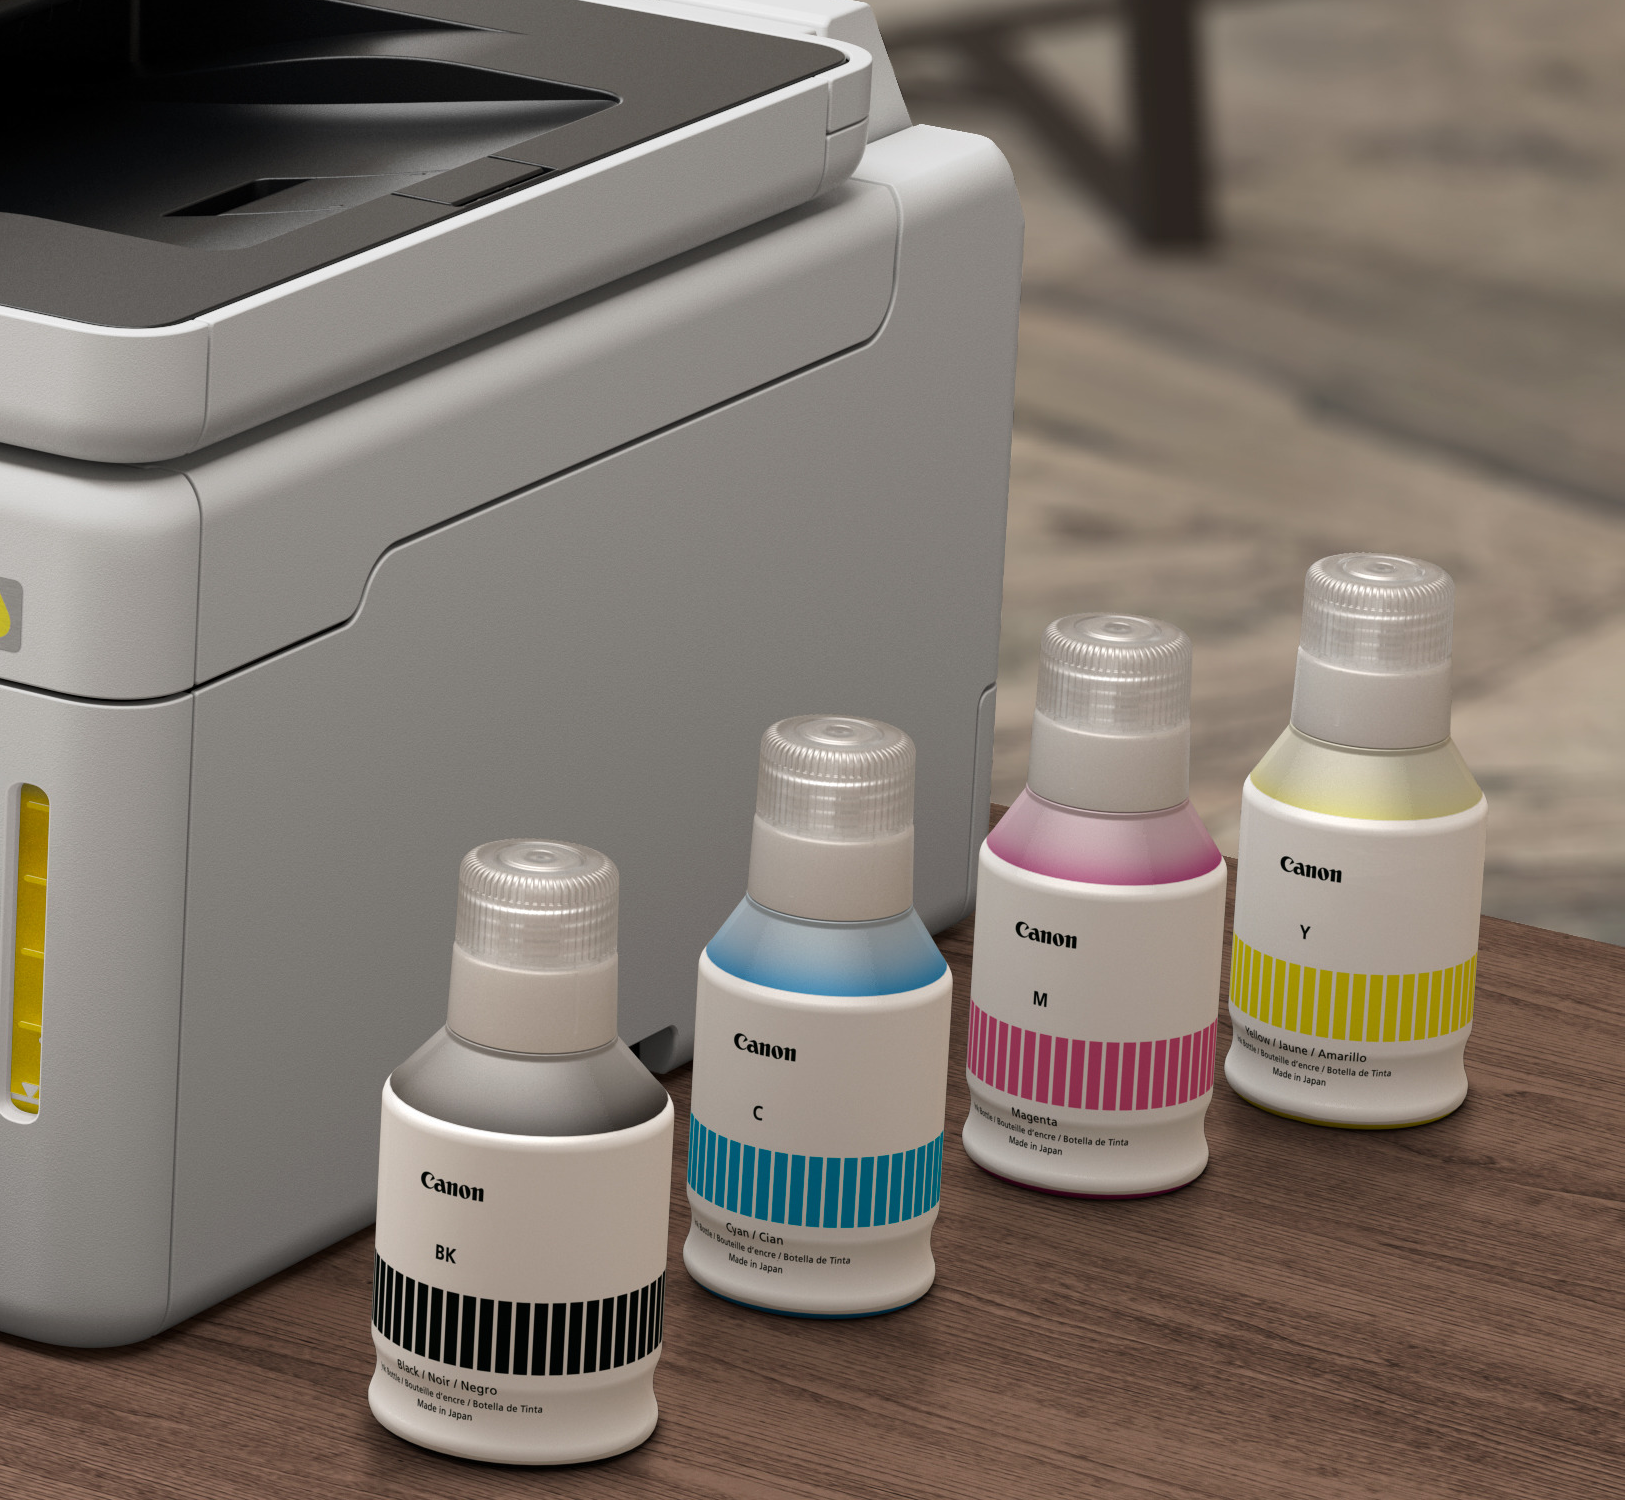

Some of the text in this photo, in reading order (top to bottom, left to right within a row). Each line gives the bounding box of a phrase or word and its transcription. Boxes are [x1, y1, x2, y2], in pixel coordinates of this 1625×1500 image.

[1279, 855, 1343, 884] Canon
[1014, 920, 1078, 950] Canon
[1299, 923, 1312, 941] Y
[1032, 990, 1048, 1009] M
[733, 1032, 797, 1063] Canon
[1244, 1025, 1367, 1063] Yellow Jaune Amarillo
[1261, 1050, 1289, 1066] Bouteille
[1327, 1066, 1356, 1077] Botella
[1358, 1069, 1369, 1077] de
[1371, 1069, 1391, 1078] Tinta
[1272, 1066, 1326, 1087] Made in Japan
[752, 1104, 764, 1122] C
[1011, 1106, 1058, 1127] Magenta
[997, 1117, 1025, 1134] Bouteille
[1063, 1135, 1093, 1146] Botella
[1095, 1138, 1106, 1146] de
[1108, 1138, 1129, 1147] Tinta
[1008, 1135, 1063, 1156] Made in Japan
[420, 1170, 485, 1204] Canon
[726, 1223, 784, 1245] Cyan Cian
[435, 1243, 457, 1265] BK
[716, 1234, 745, 1251] Bouteille
[783, 1253, 814, 1264] Botella
[816, 1256, 827, 1265] de
[830, 1256, 851, 1265] Tinta
[728, 1252, 783, 1274] Made in Japan
[397, 1359, 498, 1396] Black Noir Negro
[404, 1378, 434, 1397] Bouteille
[473, 1400, 504, 1412] Botella
[507, 1404, 518, 1413] de
[521, 1405, 543, 1414] Tinta
[417, 1398, 473, 1421] Made in Japan
